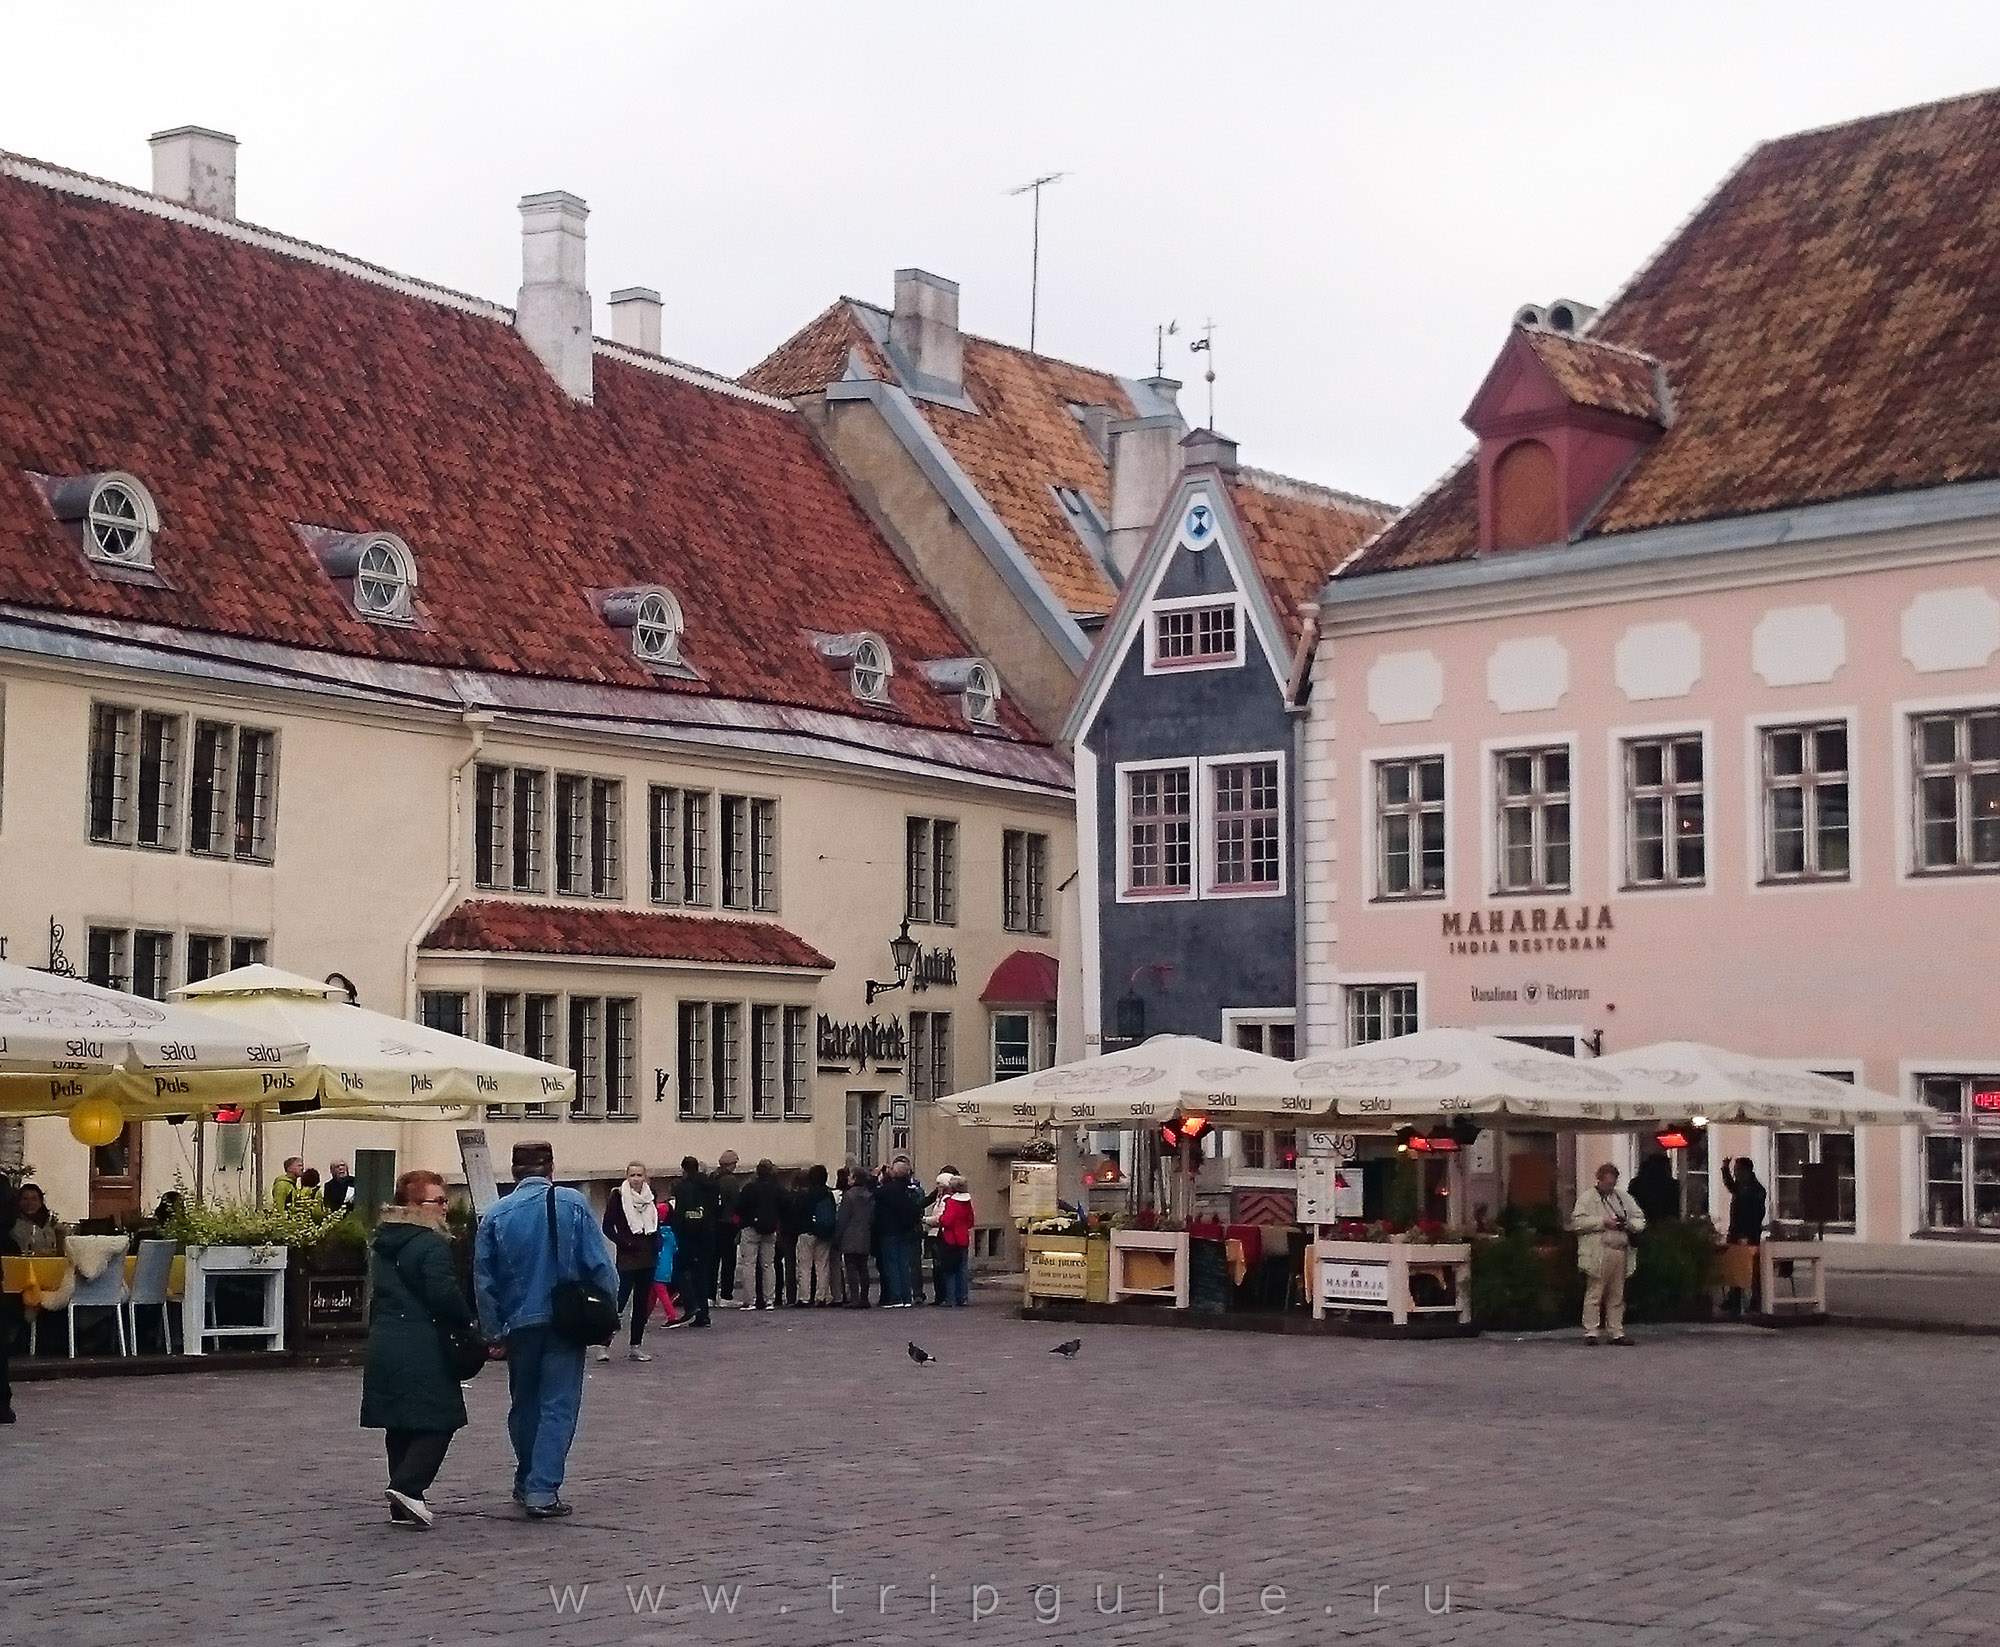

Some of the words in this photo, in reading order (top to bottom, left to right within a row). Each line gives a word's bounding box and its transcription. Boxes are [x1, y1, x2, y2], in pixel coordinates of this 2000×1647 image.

[1441, 905, 1613, 936] MAHARAJA
[1449, 939, 1499, 955] INDIA
[1509, 936, 1606, 953] RESTORAN
[66, 1038, 104, 1059] saku
[160, 1041, 197, 1061] saku
[246, 1044, 282, 1062] saku
[50, 1079, 84, 1100] Puls
[154, 1076, 189, 1097] Puls
[410, 1074, 433, 1094] Puls
[476, 1074, 499, 1094] Puls
[540, 1076, 565, 1094] Puls
[956, 1101, 980, 1114] saku
[1013, 1102, 1037, 1116] saku
[1071, 1102, 1095, 1117] saku
[1130, 1101, 1155, 1116] saku
[1207, 1092, 1238, 1106] saku
[1281, 1095, 1312, 1110] saku
[1359, 1096, 1392, 1112] saku
[1975, 1093, 2000, 1107] OPE
